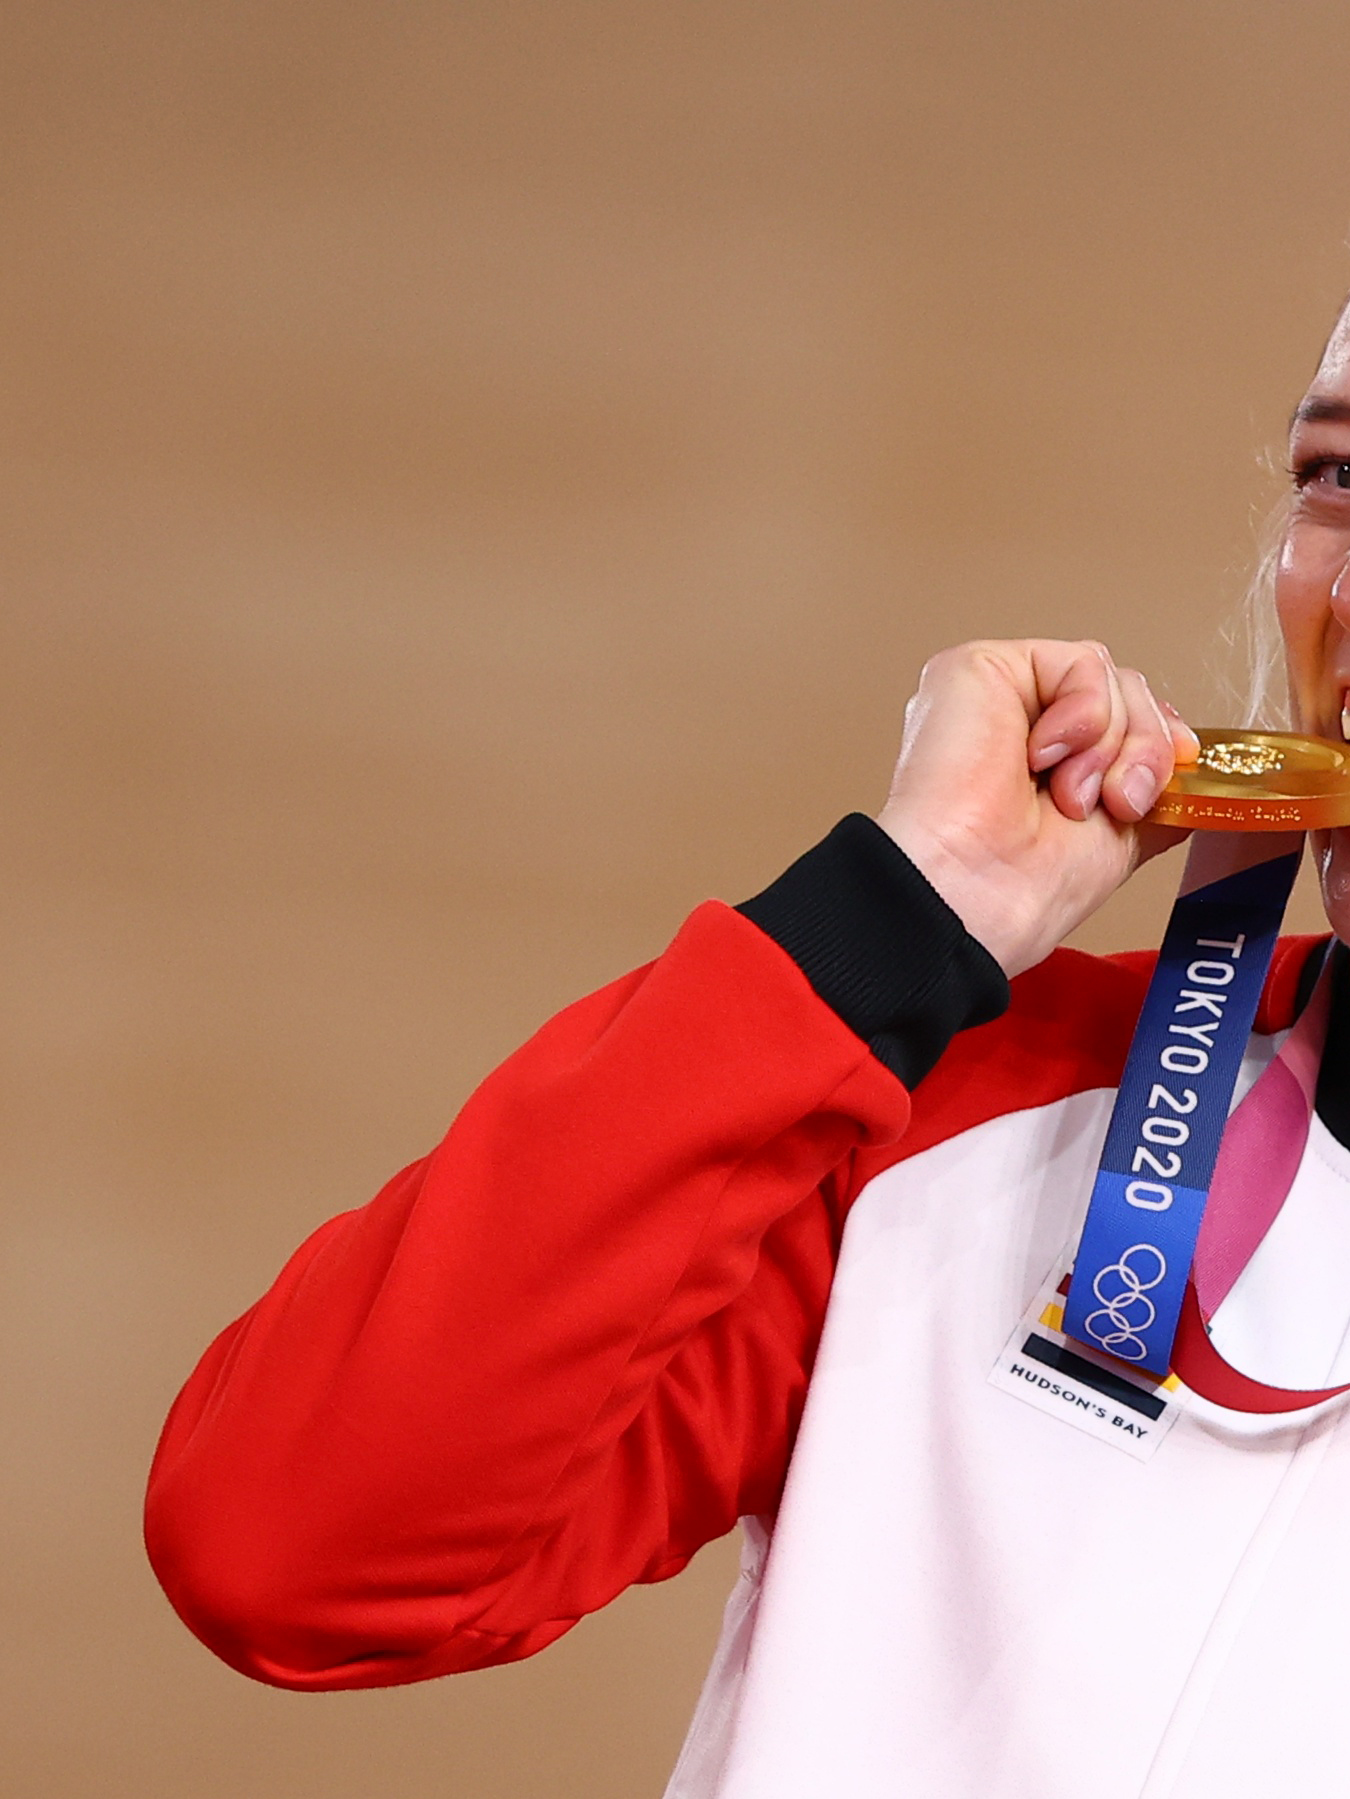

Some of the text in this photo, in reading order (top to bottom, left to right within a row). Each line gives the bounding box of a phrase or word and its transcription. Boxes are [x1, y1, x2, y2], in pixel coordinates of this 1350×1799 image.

[1125, 933, 1245, 1212] TOKYO 2020
[1009, 1363, 1149, 1440] HUDSON'S BAY
